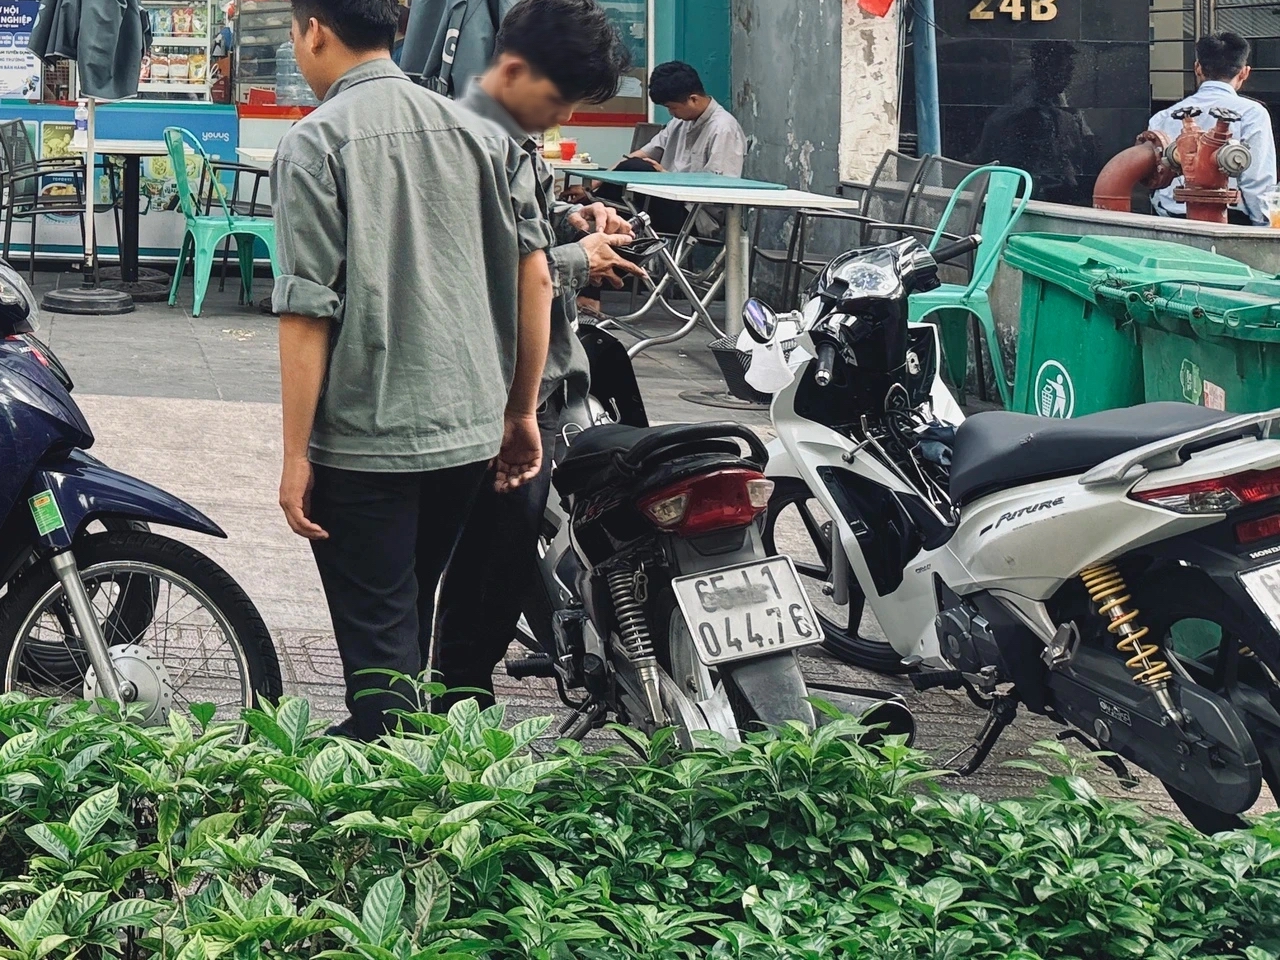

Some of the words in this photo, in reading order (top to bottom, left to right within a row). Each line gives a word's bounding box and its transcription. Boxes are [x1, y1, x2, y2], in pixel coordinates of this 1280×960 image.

[3, 5, 19, 16] HỘI
[0, 15, 32, 26] NGHIỆP
[994, 496, 1066, 530] FUTURE
